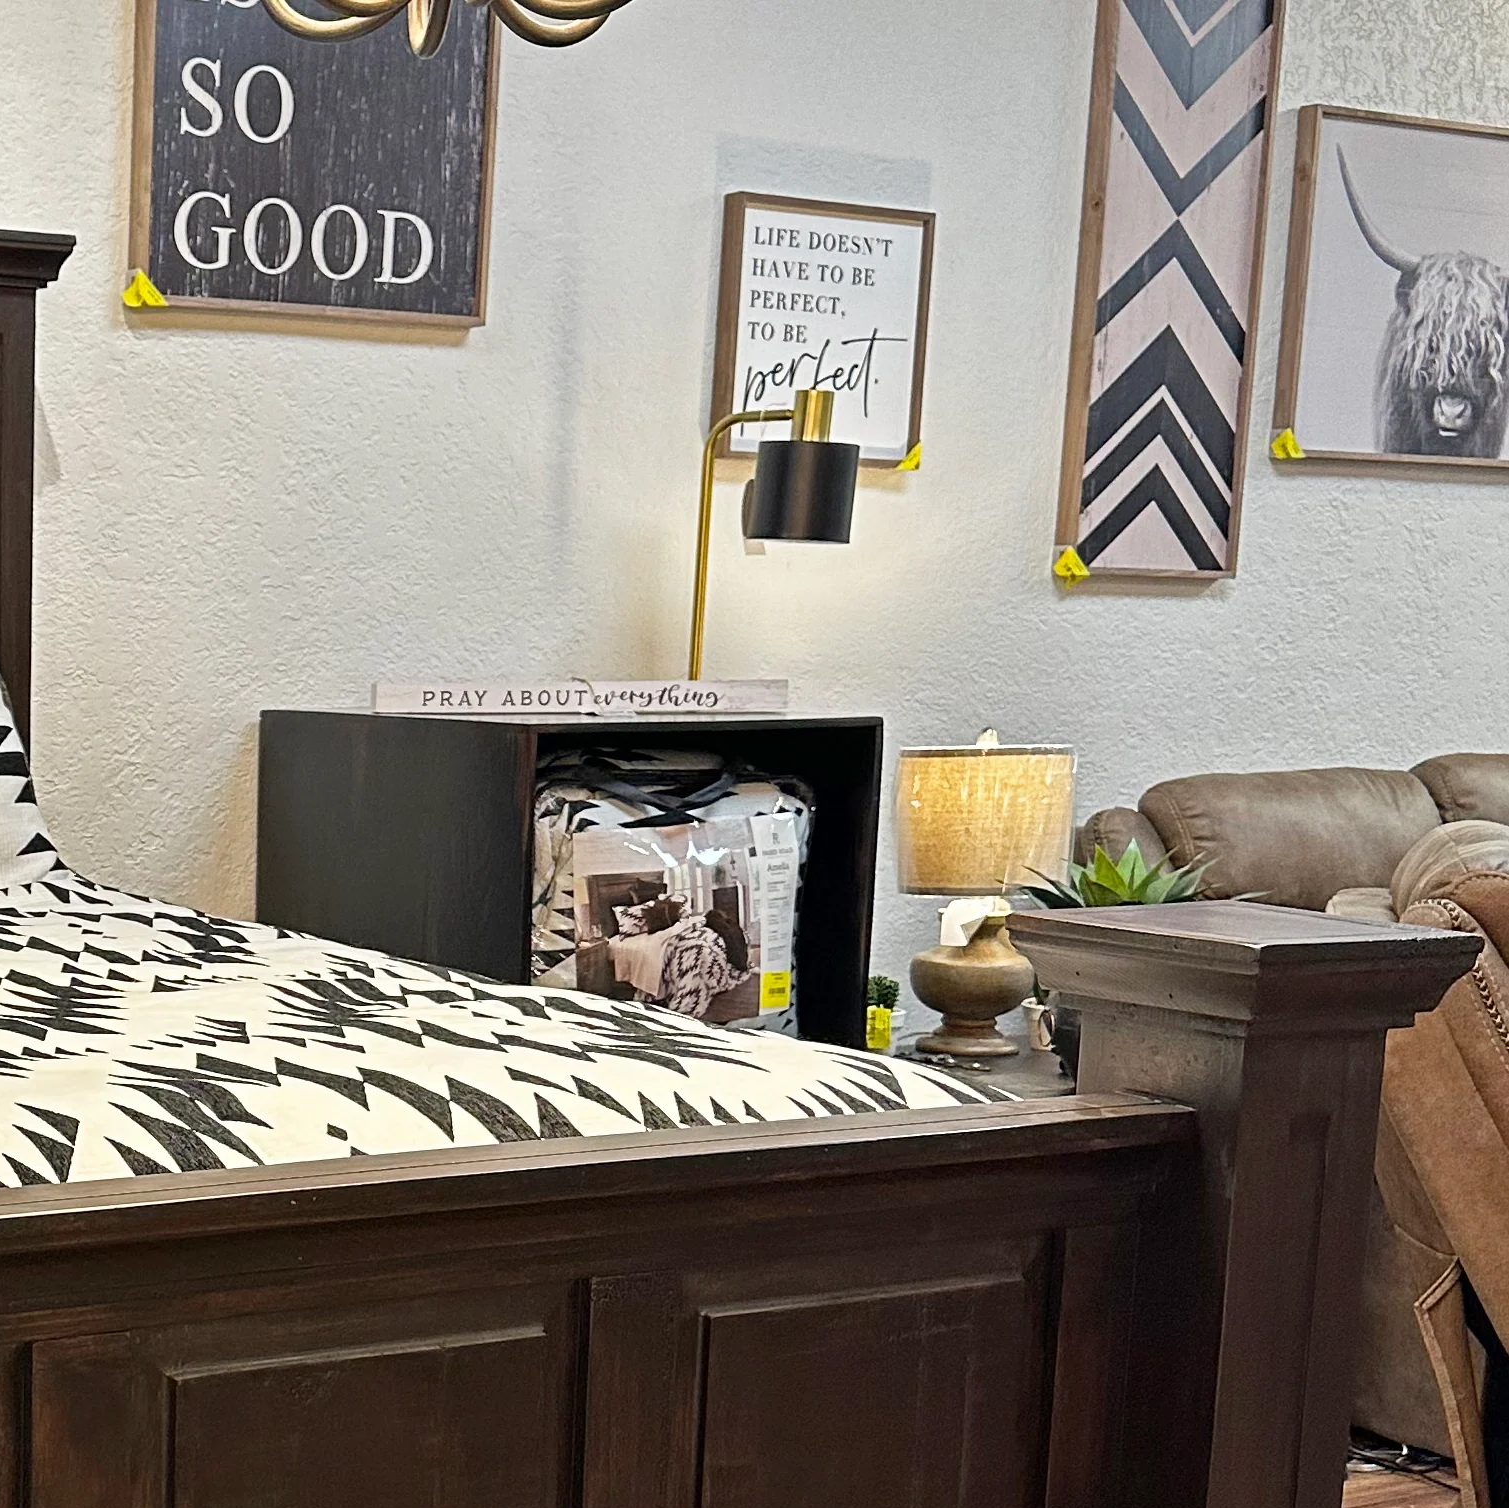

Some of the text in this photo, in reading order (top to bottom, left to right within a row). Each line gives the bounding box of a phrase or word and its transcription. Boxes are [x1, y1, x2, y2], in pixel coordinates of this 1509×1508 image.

[179, 56, 294, 144] SO
[173, 190, 435, 286] GOOD
[754, 225, 893, 257] LIFE DOESN'T
[751, 258, 875, 287] HAVE TO BE
[748, 289, 846, 318] PERFECT,
[747, 321, 808, 344] TO BE
[421, 683, 724, 708] PRAY ABOUT everything
